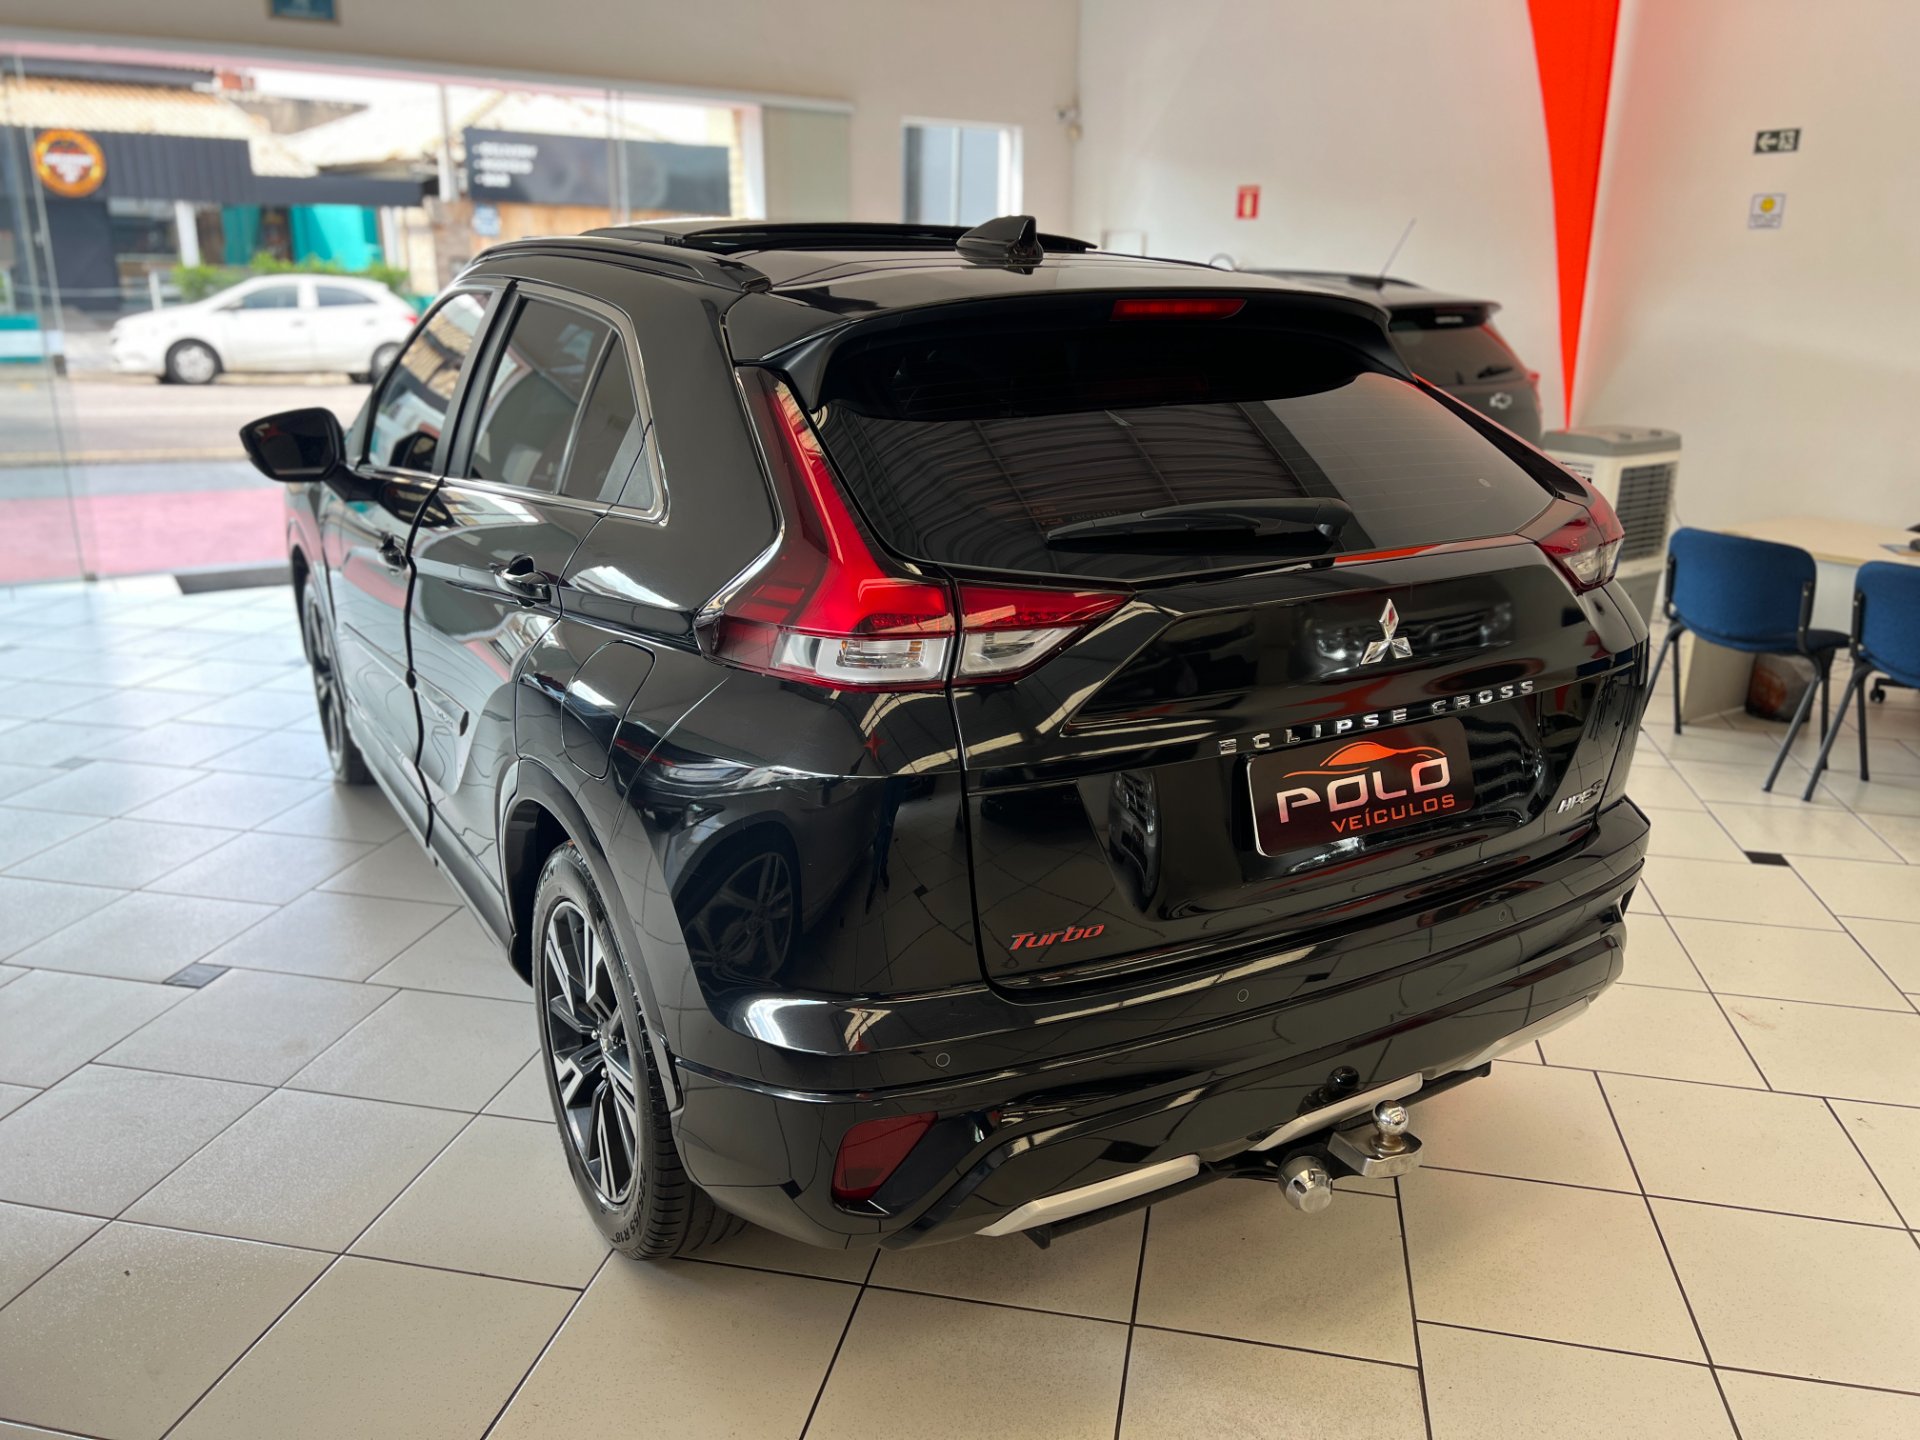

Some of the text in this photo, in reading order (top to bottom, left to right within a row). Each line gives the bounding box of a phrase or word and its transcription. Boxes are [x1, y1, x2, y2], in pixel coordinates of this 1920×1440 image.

[1218, 681, 1533, 755] ECLIPSE CROSS
[1276, 757, 1450, 823] POLO
[1331, 794, 1455, 833] VEÍCULOS
[1010, 923, 1105, 951] Turbo
